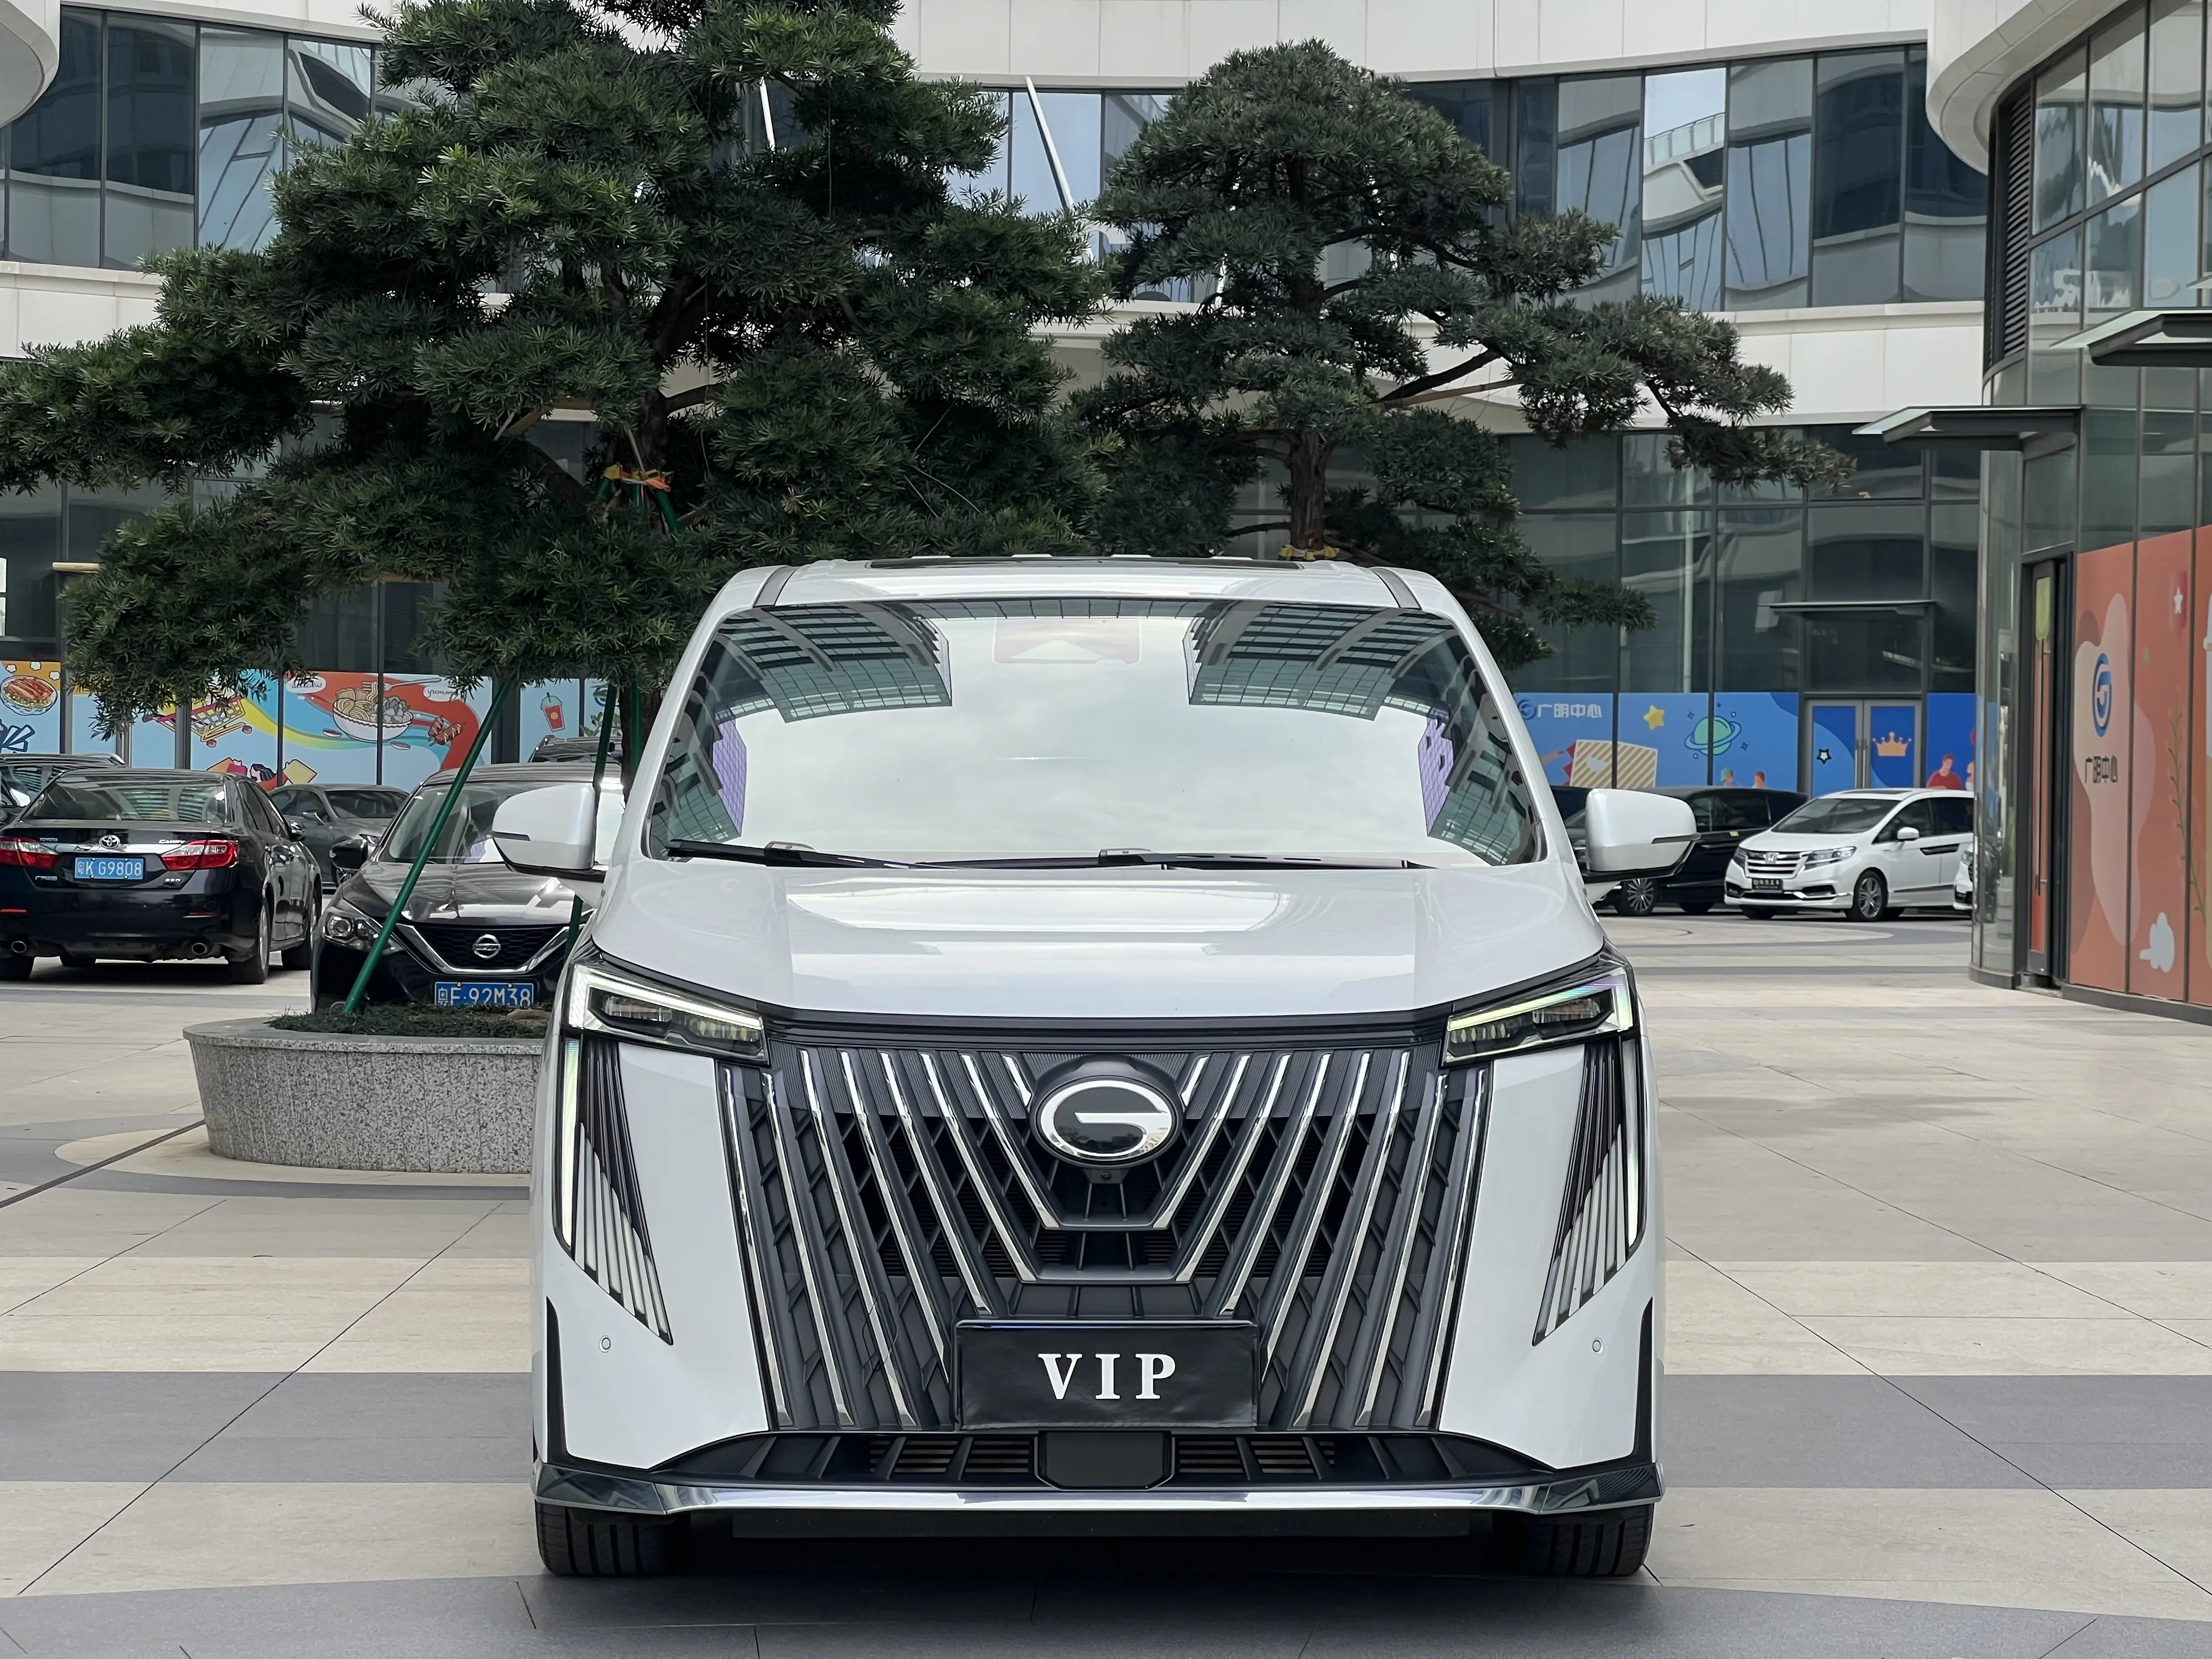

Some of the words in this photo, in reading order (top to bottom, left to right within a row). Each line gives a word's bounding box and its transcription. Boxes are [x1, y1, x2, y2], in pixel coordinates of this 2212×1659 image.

[1537, 703, 1602, 718] 广明中心
[1037, 1353, 1176, 1400] VIP
